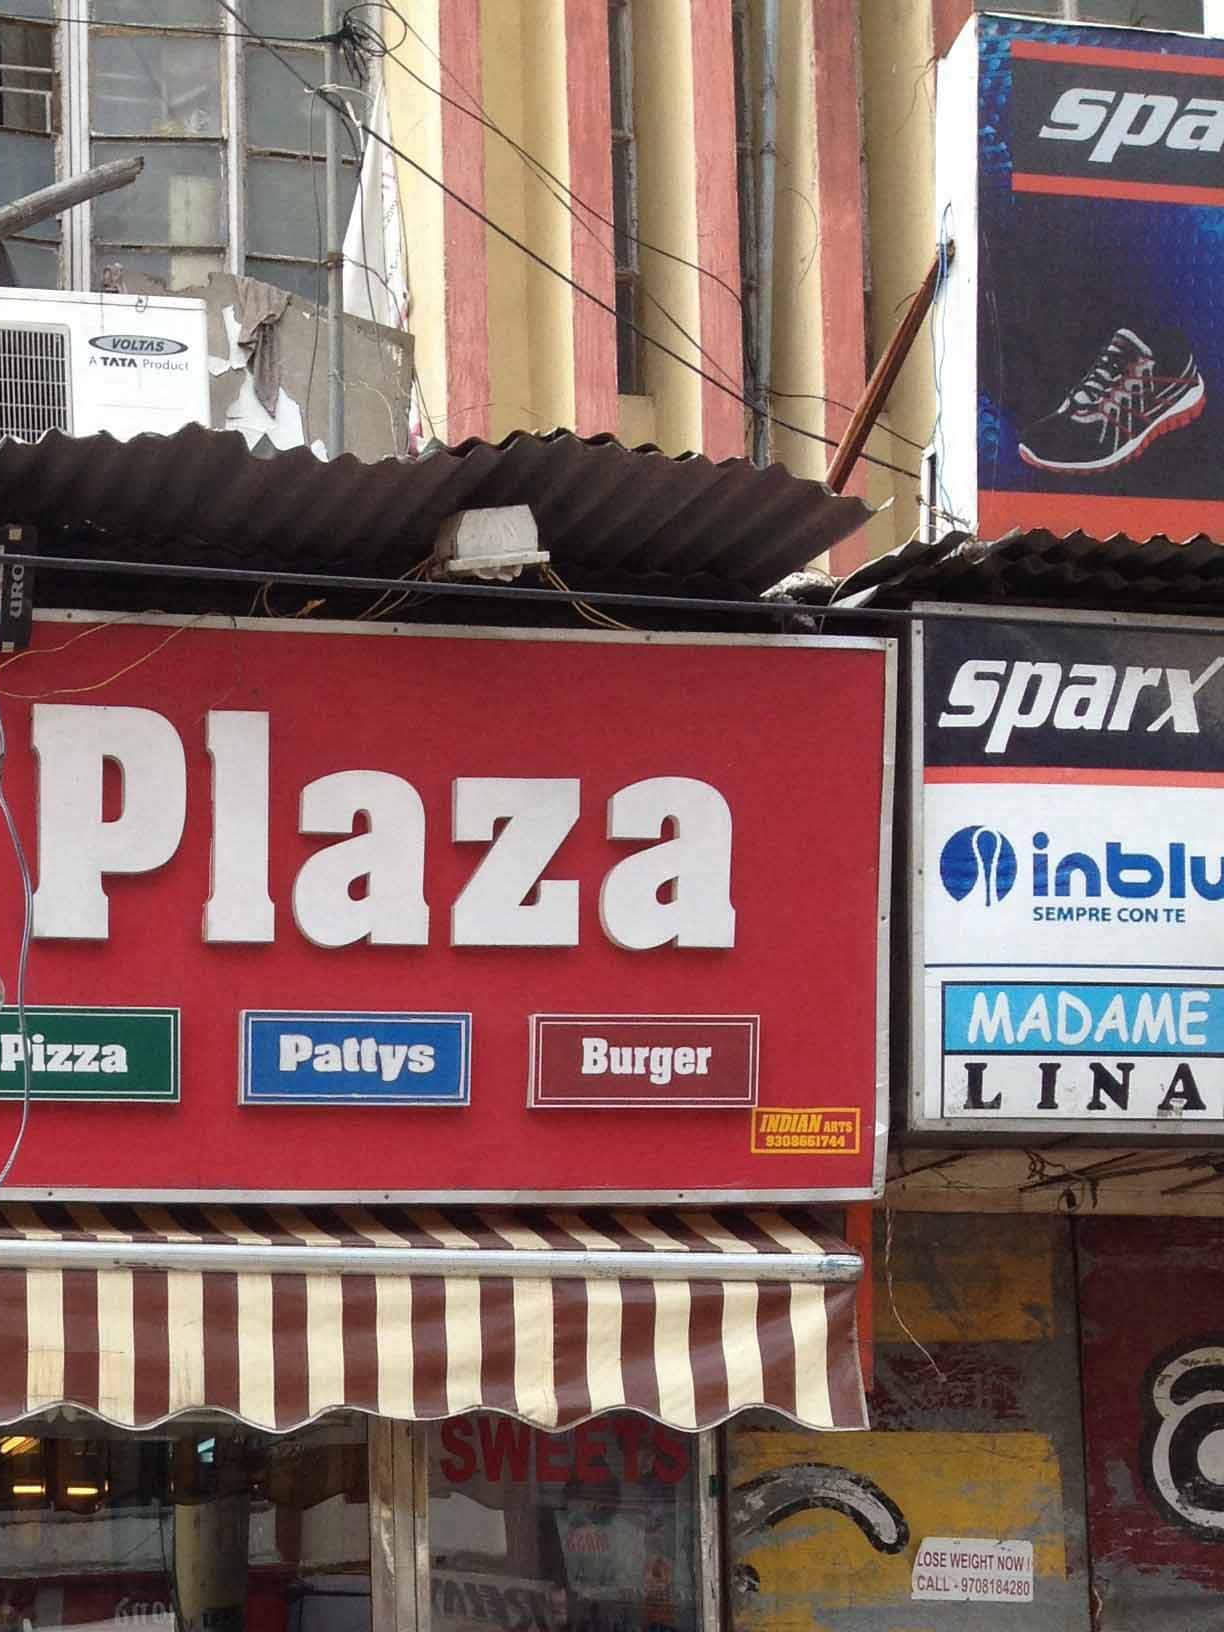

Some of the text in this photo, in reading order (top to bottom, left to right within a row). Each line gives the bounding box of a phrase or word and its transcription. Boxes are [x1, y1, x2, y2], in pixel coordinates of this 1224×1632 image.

[88, 355, 190, 371] A TATA Product
[111, 338, 166, 353] VOLTAS
[31, 703, 737, 951] Plaza
[1032, 906, 1187, 924] SEMPRE CON TE
[967, 990, 1211, 1046] MADAME
[0, 1032, 129, 1076] Pizza
[278, 1033, 437, 1080] Pattys
[580, 1036, 713, 1085] Burger
[962, 1062, 1208, 1112] LINA
[760, 1114, 854, 1134] INDIAN ARTS
[439, 1412, 690, 1484] SWEETS
[917, 1551, 947, 1567] LOSE
[950, 1553, 994, 1569] WEIGHT
[997, 1556, 1024, 1571] NOW
[917, 1575, 950, 1592] CALL
